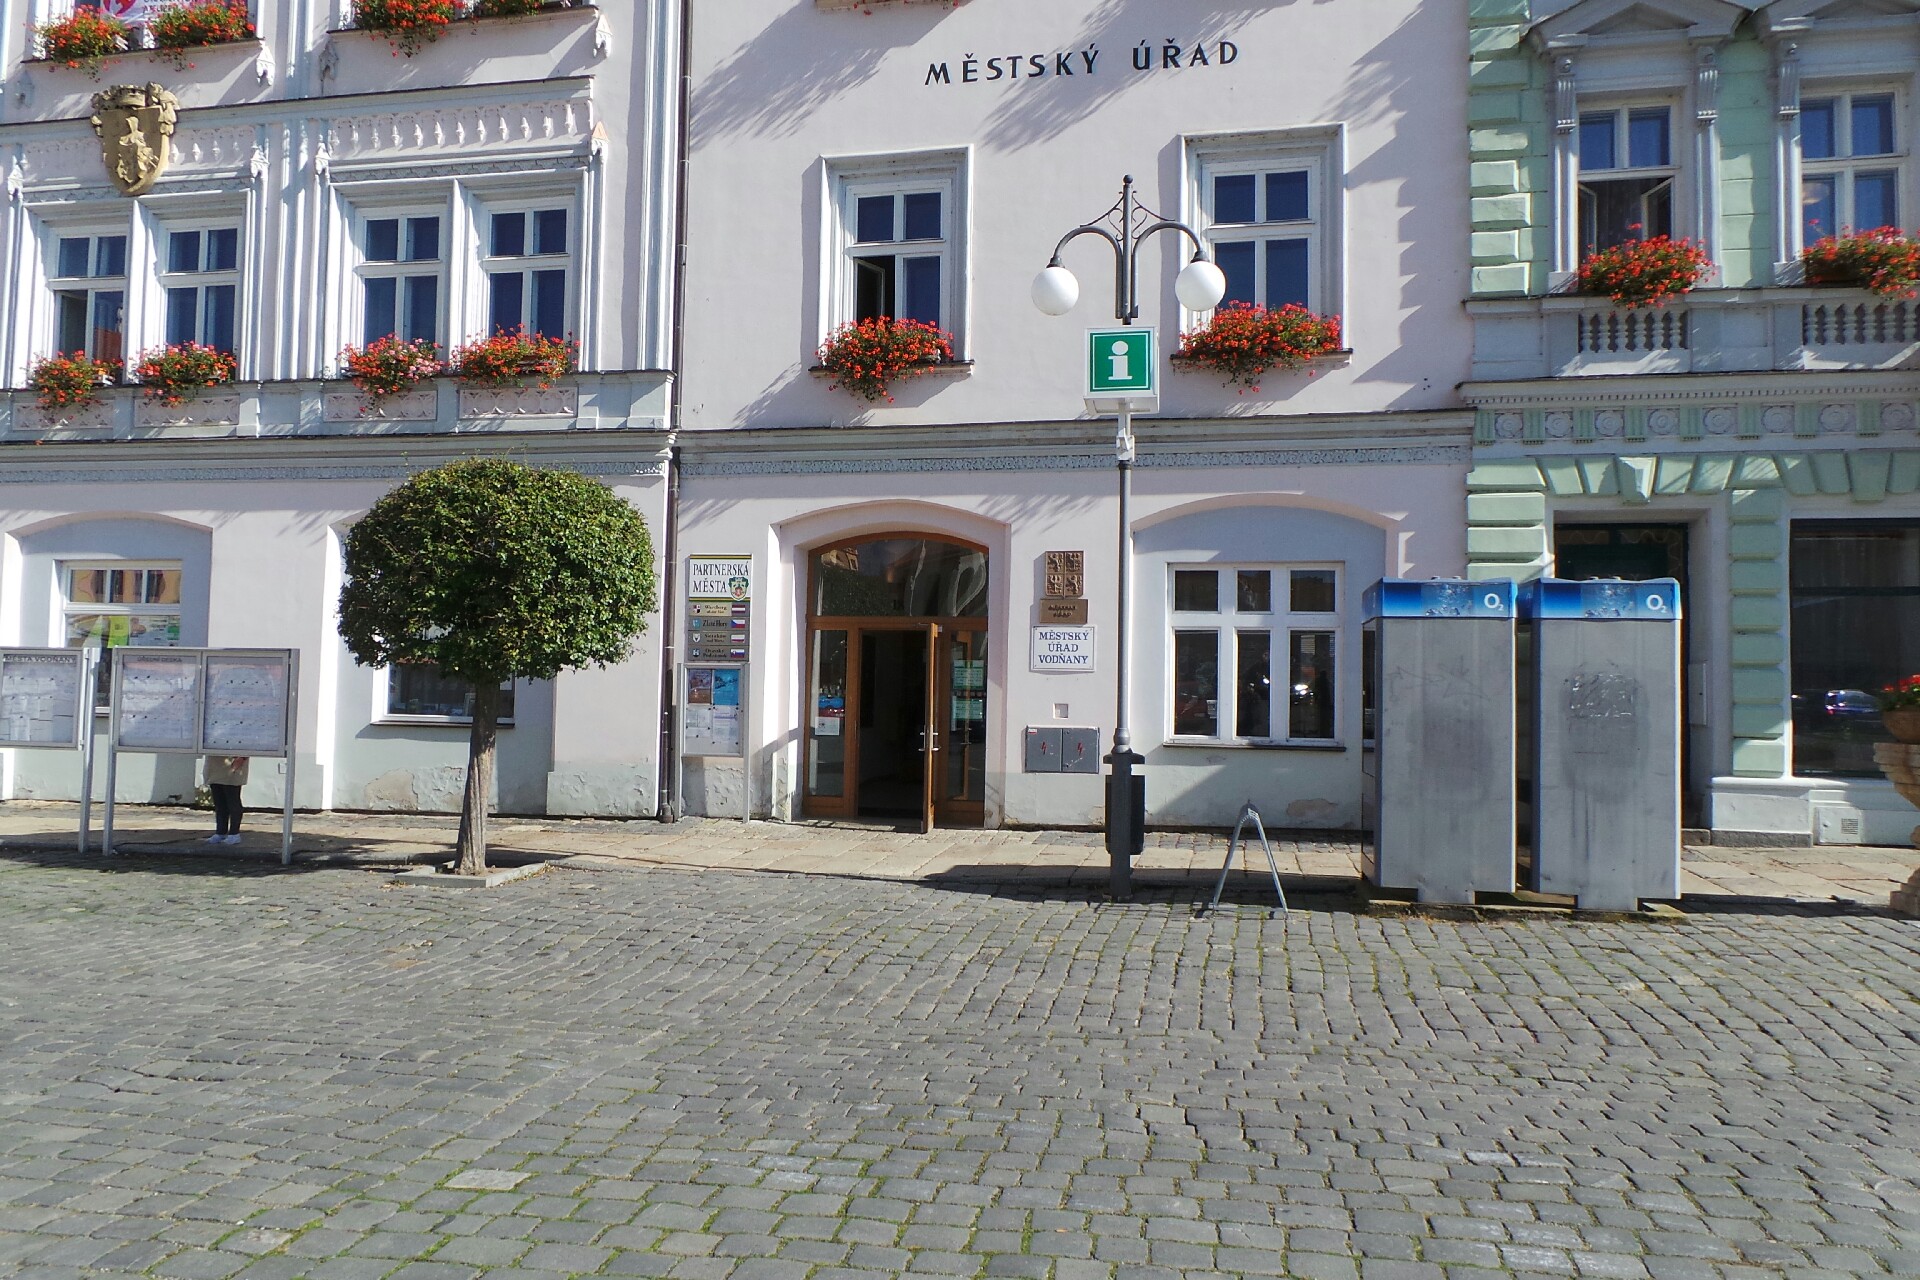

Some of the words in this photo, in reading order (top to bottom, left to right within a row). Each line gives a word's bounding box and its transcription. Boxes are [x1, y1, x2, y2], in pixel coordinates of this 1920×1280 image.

[924, 43, 1099, 86] MĚSTSKÝ
[1132, 38, 1238, 71] ÚŘAD
[693, 560, 749, 576] PARTNERSKÁ
[692, 577, 728, 593] MĚSTA
[1484, 593, 1504, 611] O2
[1646, 594, 1667, 613] O2
[1039, 629, 1089, 641] MĚSTSKÝ
[1048, 641, 1079, 653] ÚŘAD
[1038, 653, 1089, 664] VODŇANY
